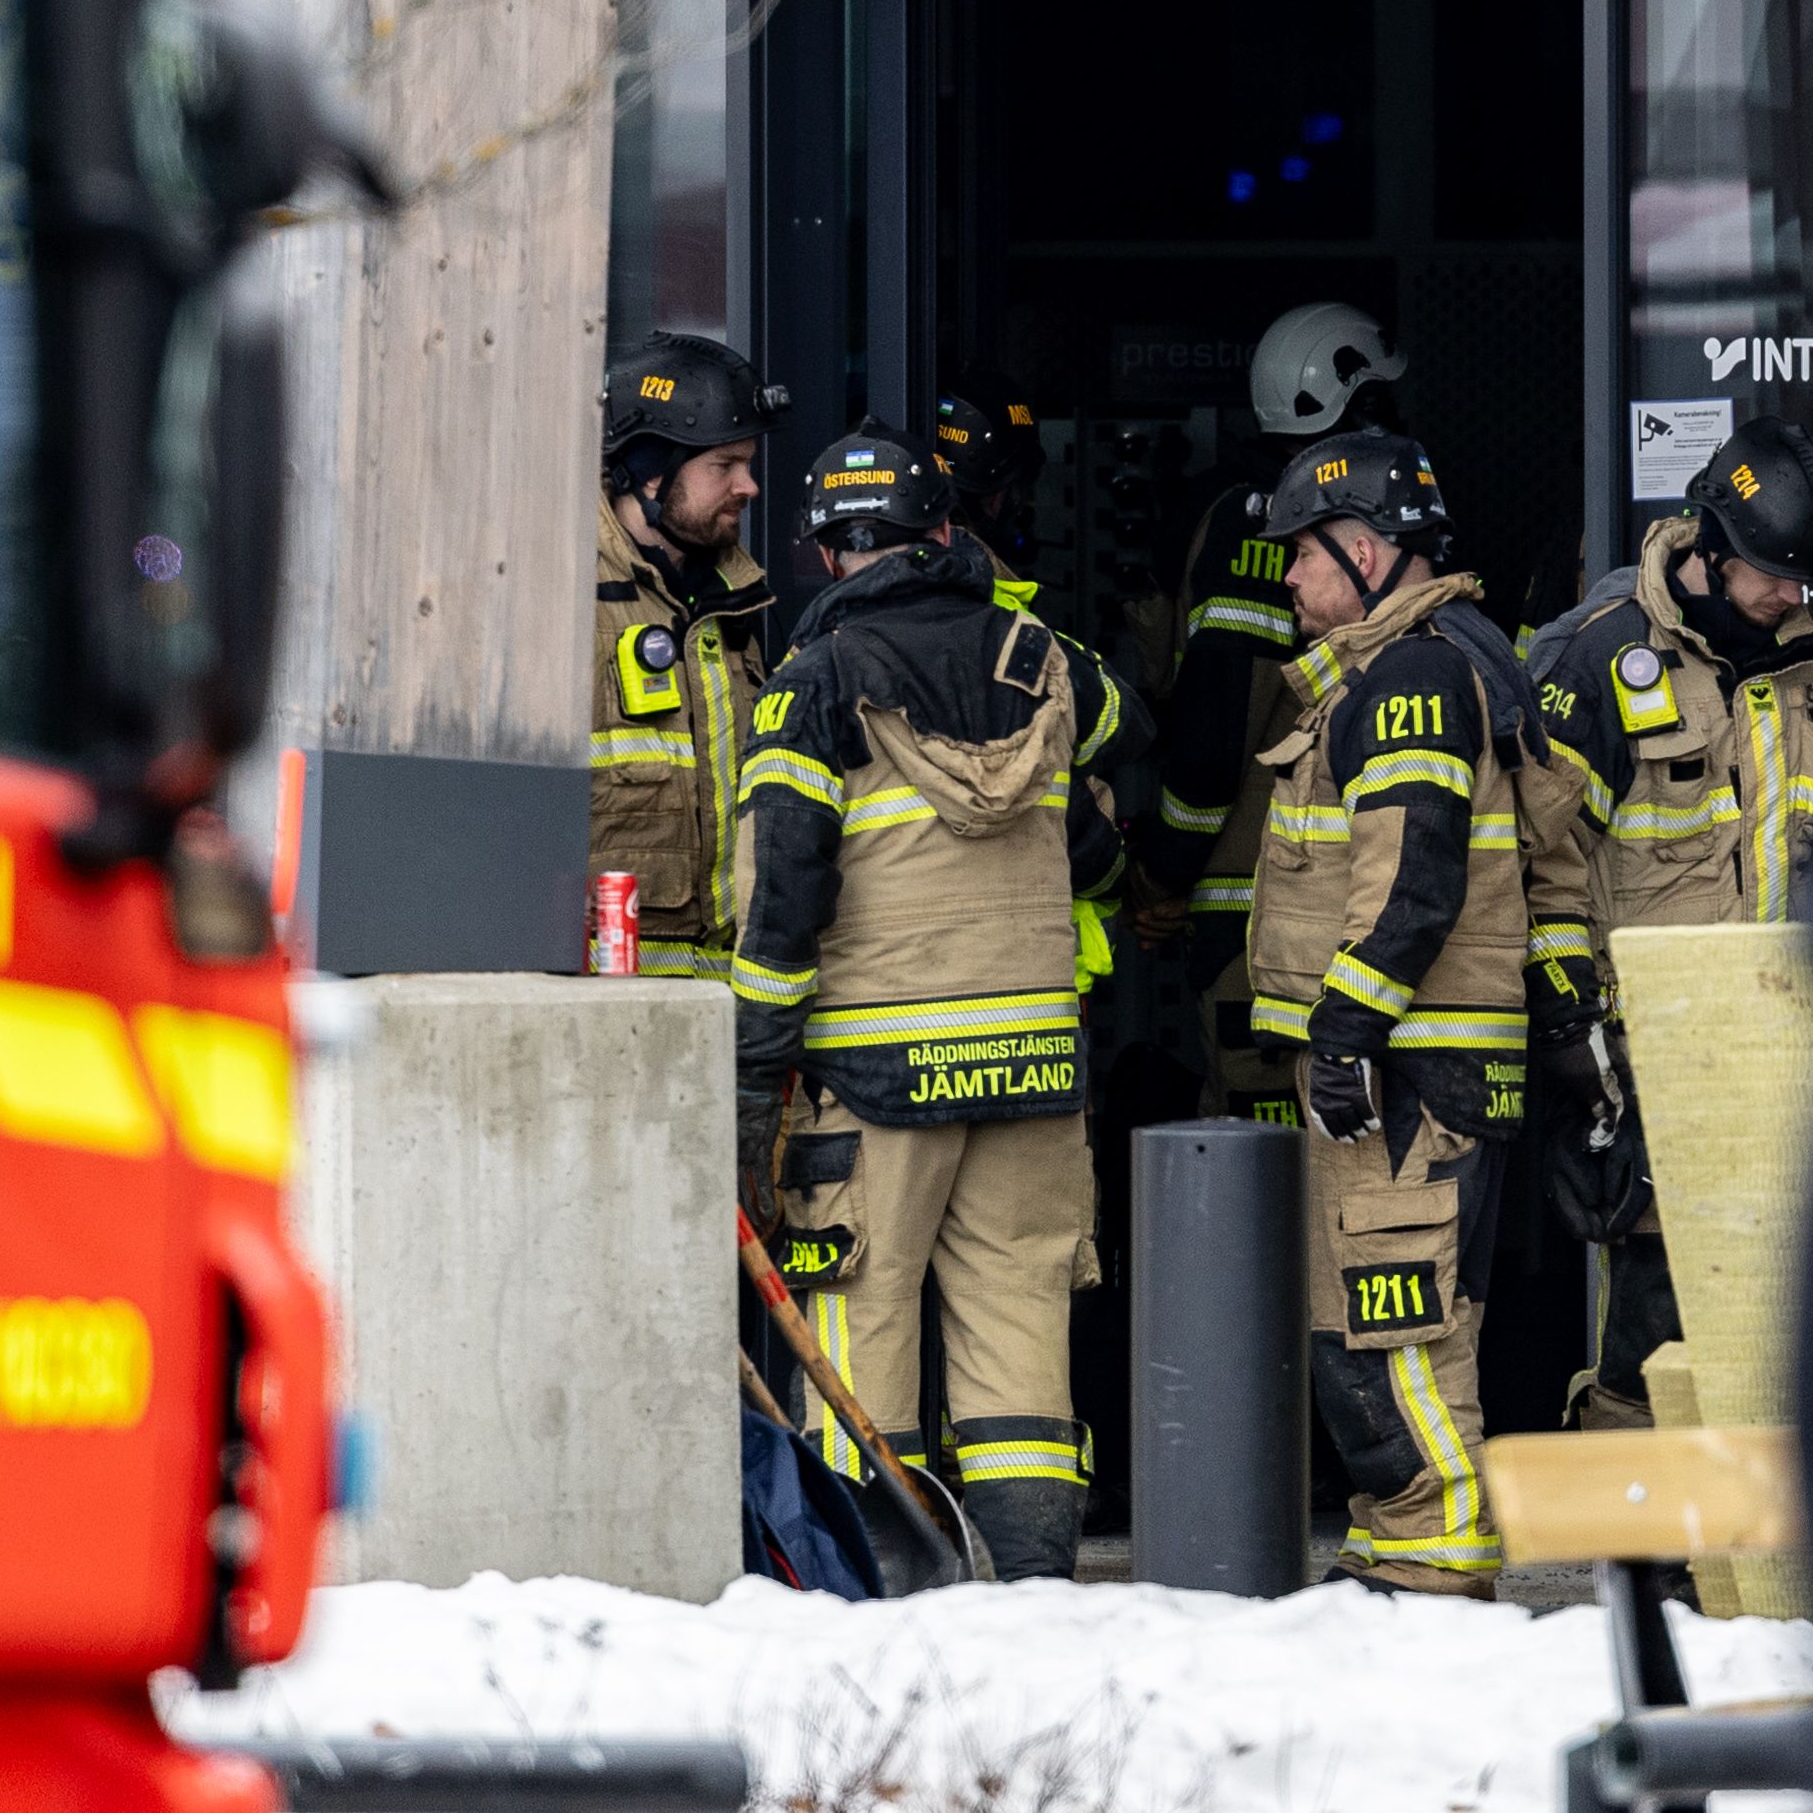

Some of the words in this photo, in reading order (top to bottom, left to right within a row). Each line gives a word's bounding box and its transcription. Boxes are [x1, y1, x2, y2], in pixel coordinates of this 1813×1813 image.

[640, 375, 675, 402] 1213
[823, 470, 896, 490] ÖSTERSUND
[1316, 459, 1348, 484] 1211
[1730, 464, 1761, 500] 1214
[1231, 539, 1285, 583] JTH
[1376, 695, 1443, 741] 1211
[1541, 683, 1576, 720] 214
[908, 1035, 1075, 1066] RÄDDNINGSTJÄNSTEN
[909, 1062, 1075, 1103] JÄMTLAND
[1357, 1274, 1424, 1321] 1211
